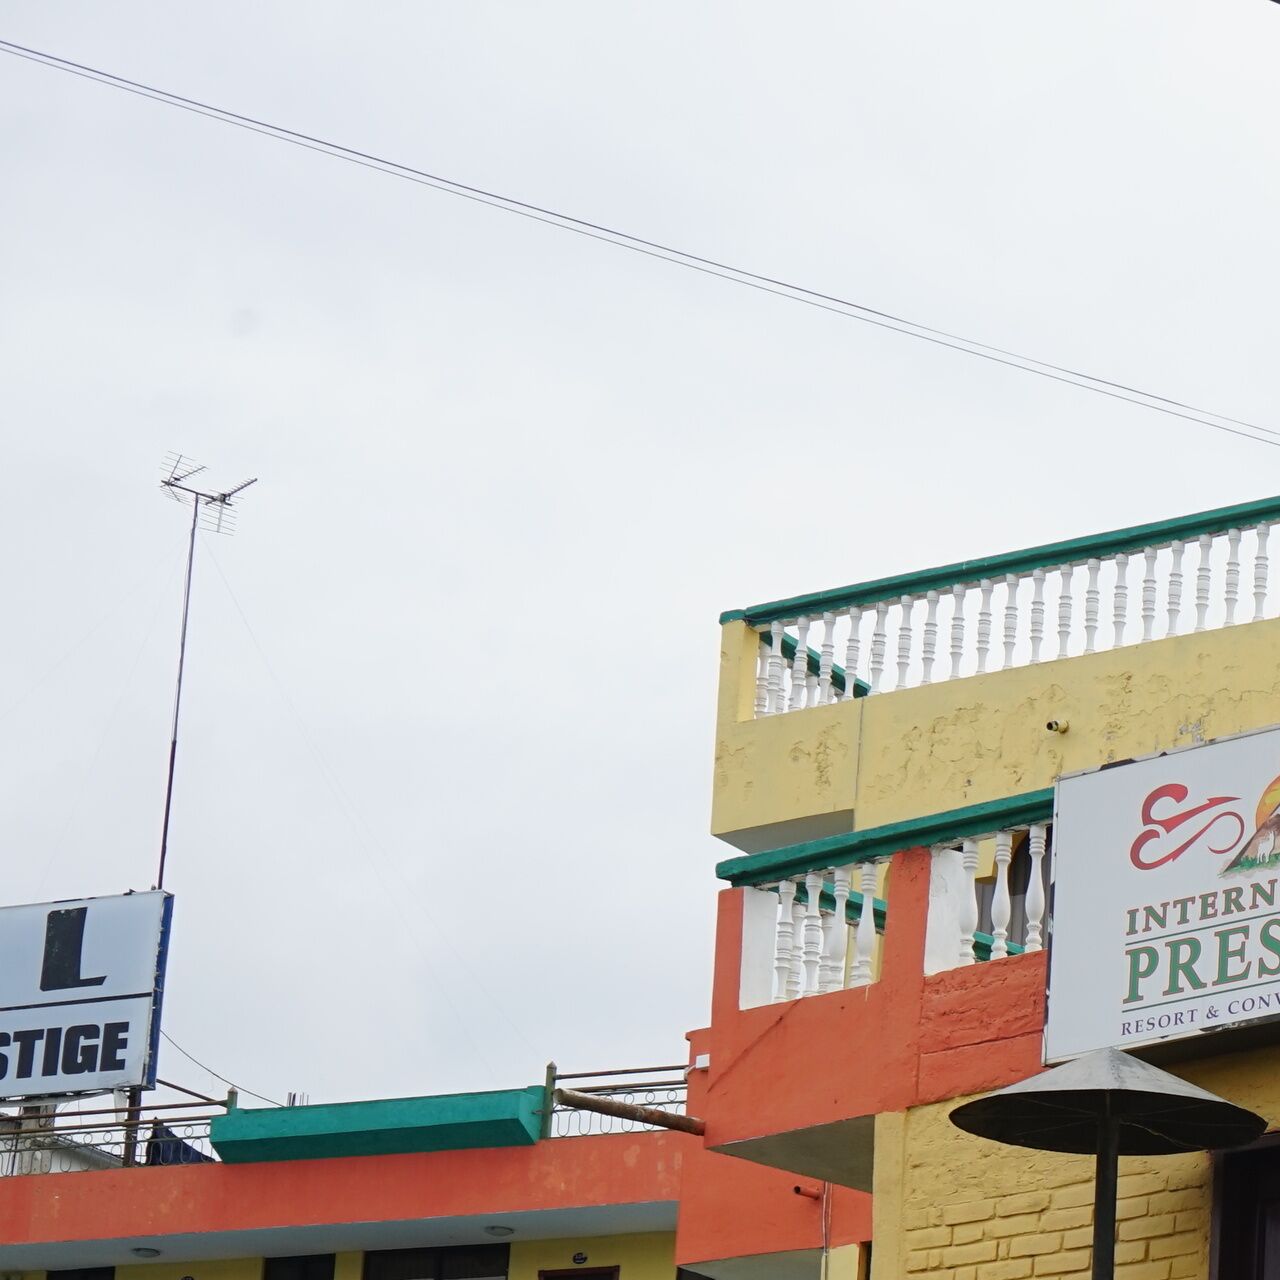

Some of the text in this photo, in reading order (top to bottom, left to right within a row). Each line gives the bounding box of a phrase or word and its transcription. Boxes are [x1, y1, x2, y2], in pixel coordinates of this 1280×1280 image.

[1121, 1009, 1198, 1036] RESORT
[1206, 1004, 1220, 1019] &
[0, 1021, 129, 1081] TIGE
